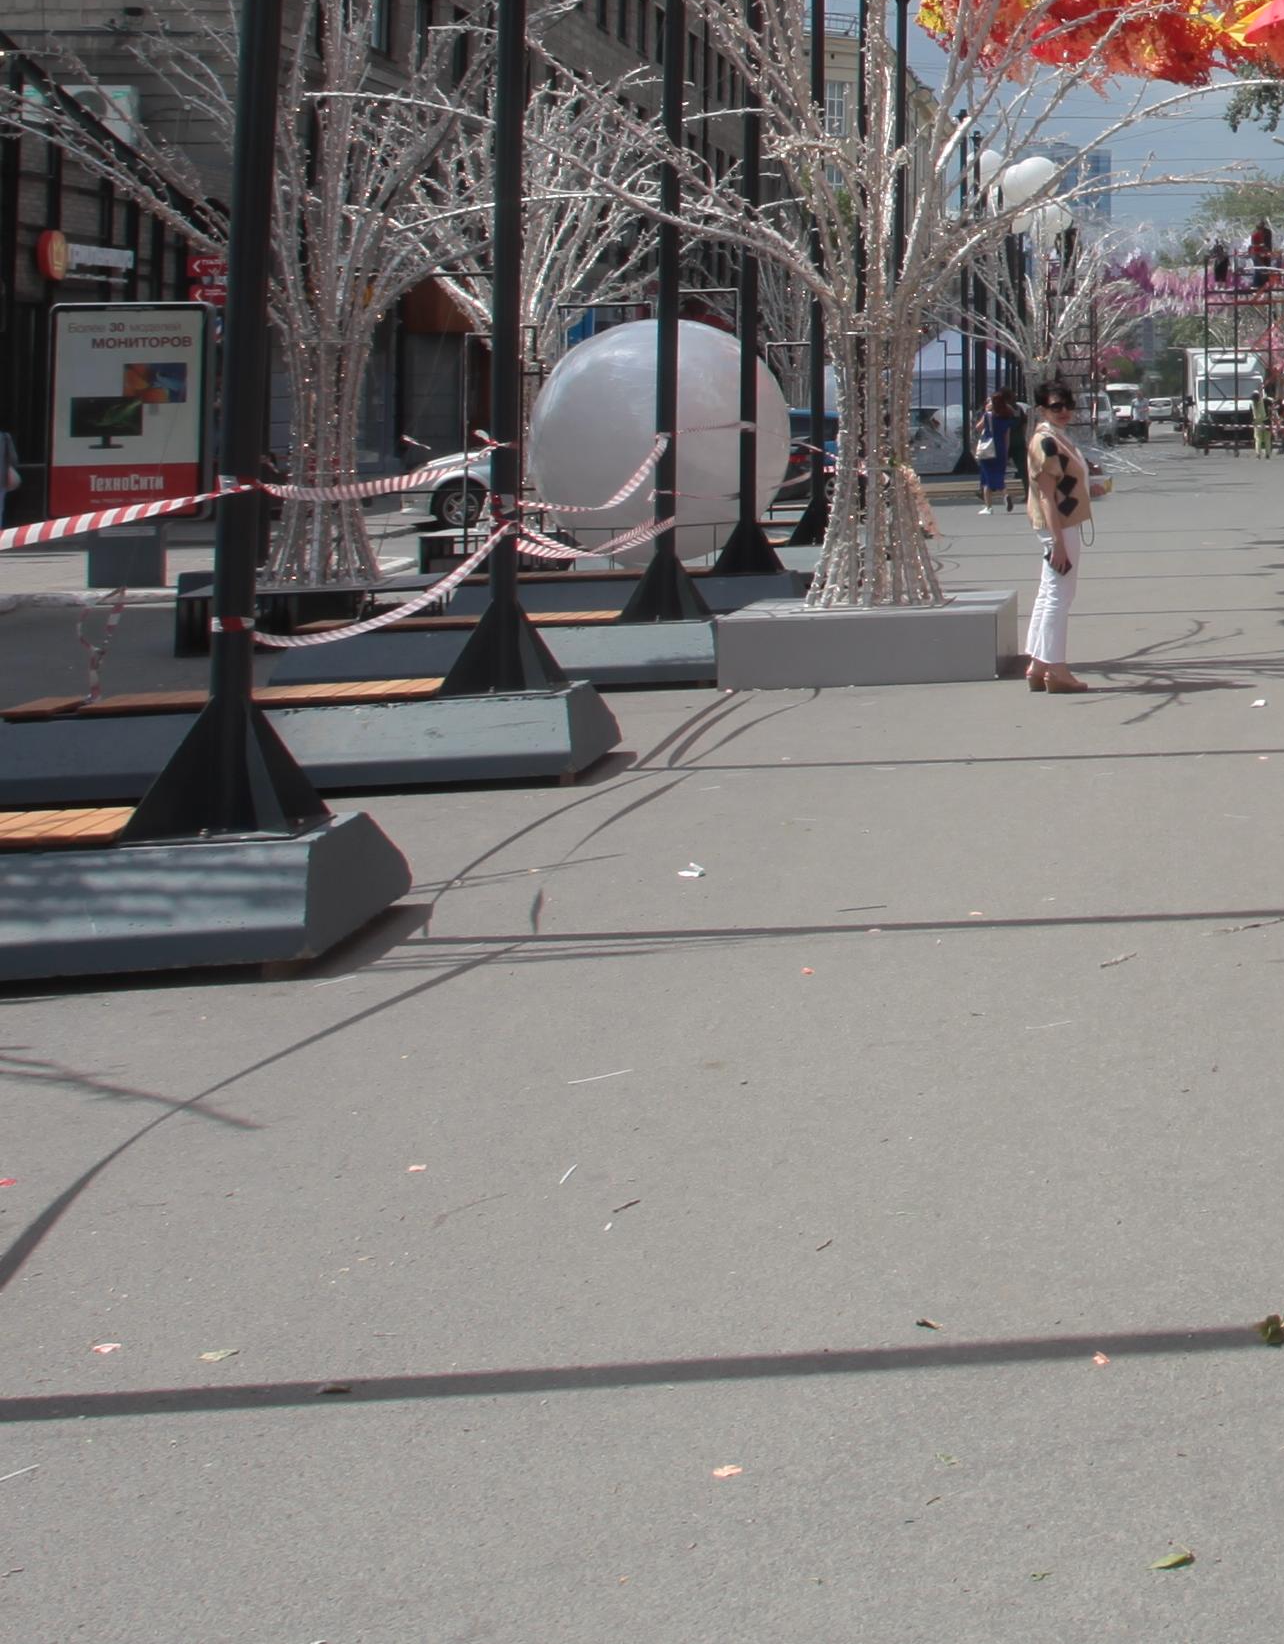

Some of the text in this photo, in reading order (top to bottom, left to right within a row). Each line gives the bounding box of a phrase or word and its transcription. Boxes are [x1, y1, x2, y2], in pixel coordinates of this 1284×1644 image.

[108, 322, 126, 333] 30
[91, 335, 193, 349] МОНИТОРОВ
[89, 473, 165, 492] ТехноСити
